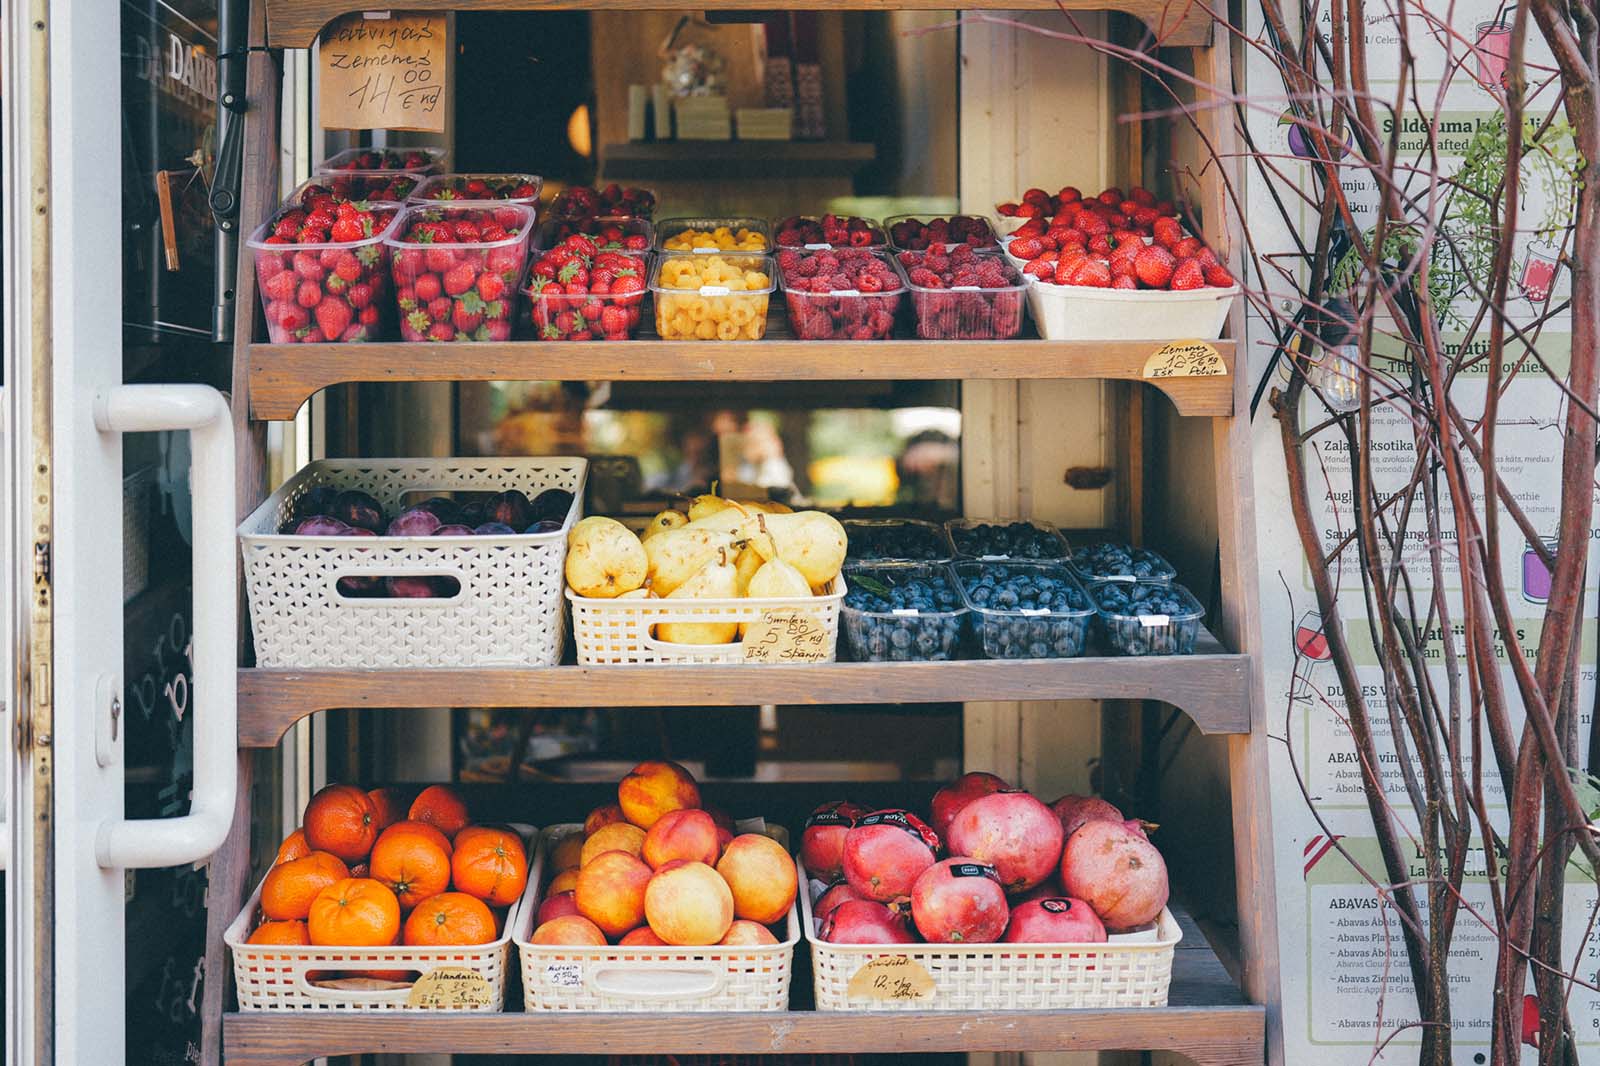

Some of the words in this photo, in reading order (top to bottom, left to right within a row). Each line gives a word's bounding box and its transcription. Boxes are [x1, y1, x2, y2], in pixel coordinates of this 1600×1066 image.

[1329, 898, 1378, 909] ABAVAS
[1337, 918, 1367, 926] Abavas
[1338, 949, 1369, 957] Abavas
[1338, 975, 1370, 983] Abavas
[1338, 1019, 1371, 1028] Abavas
